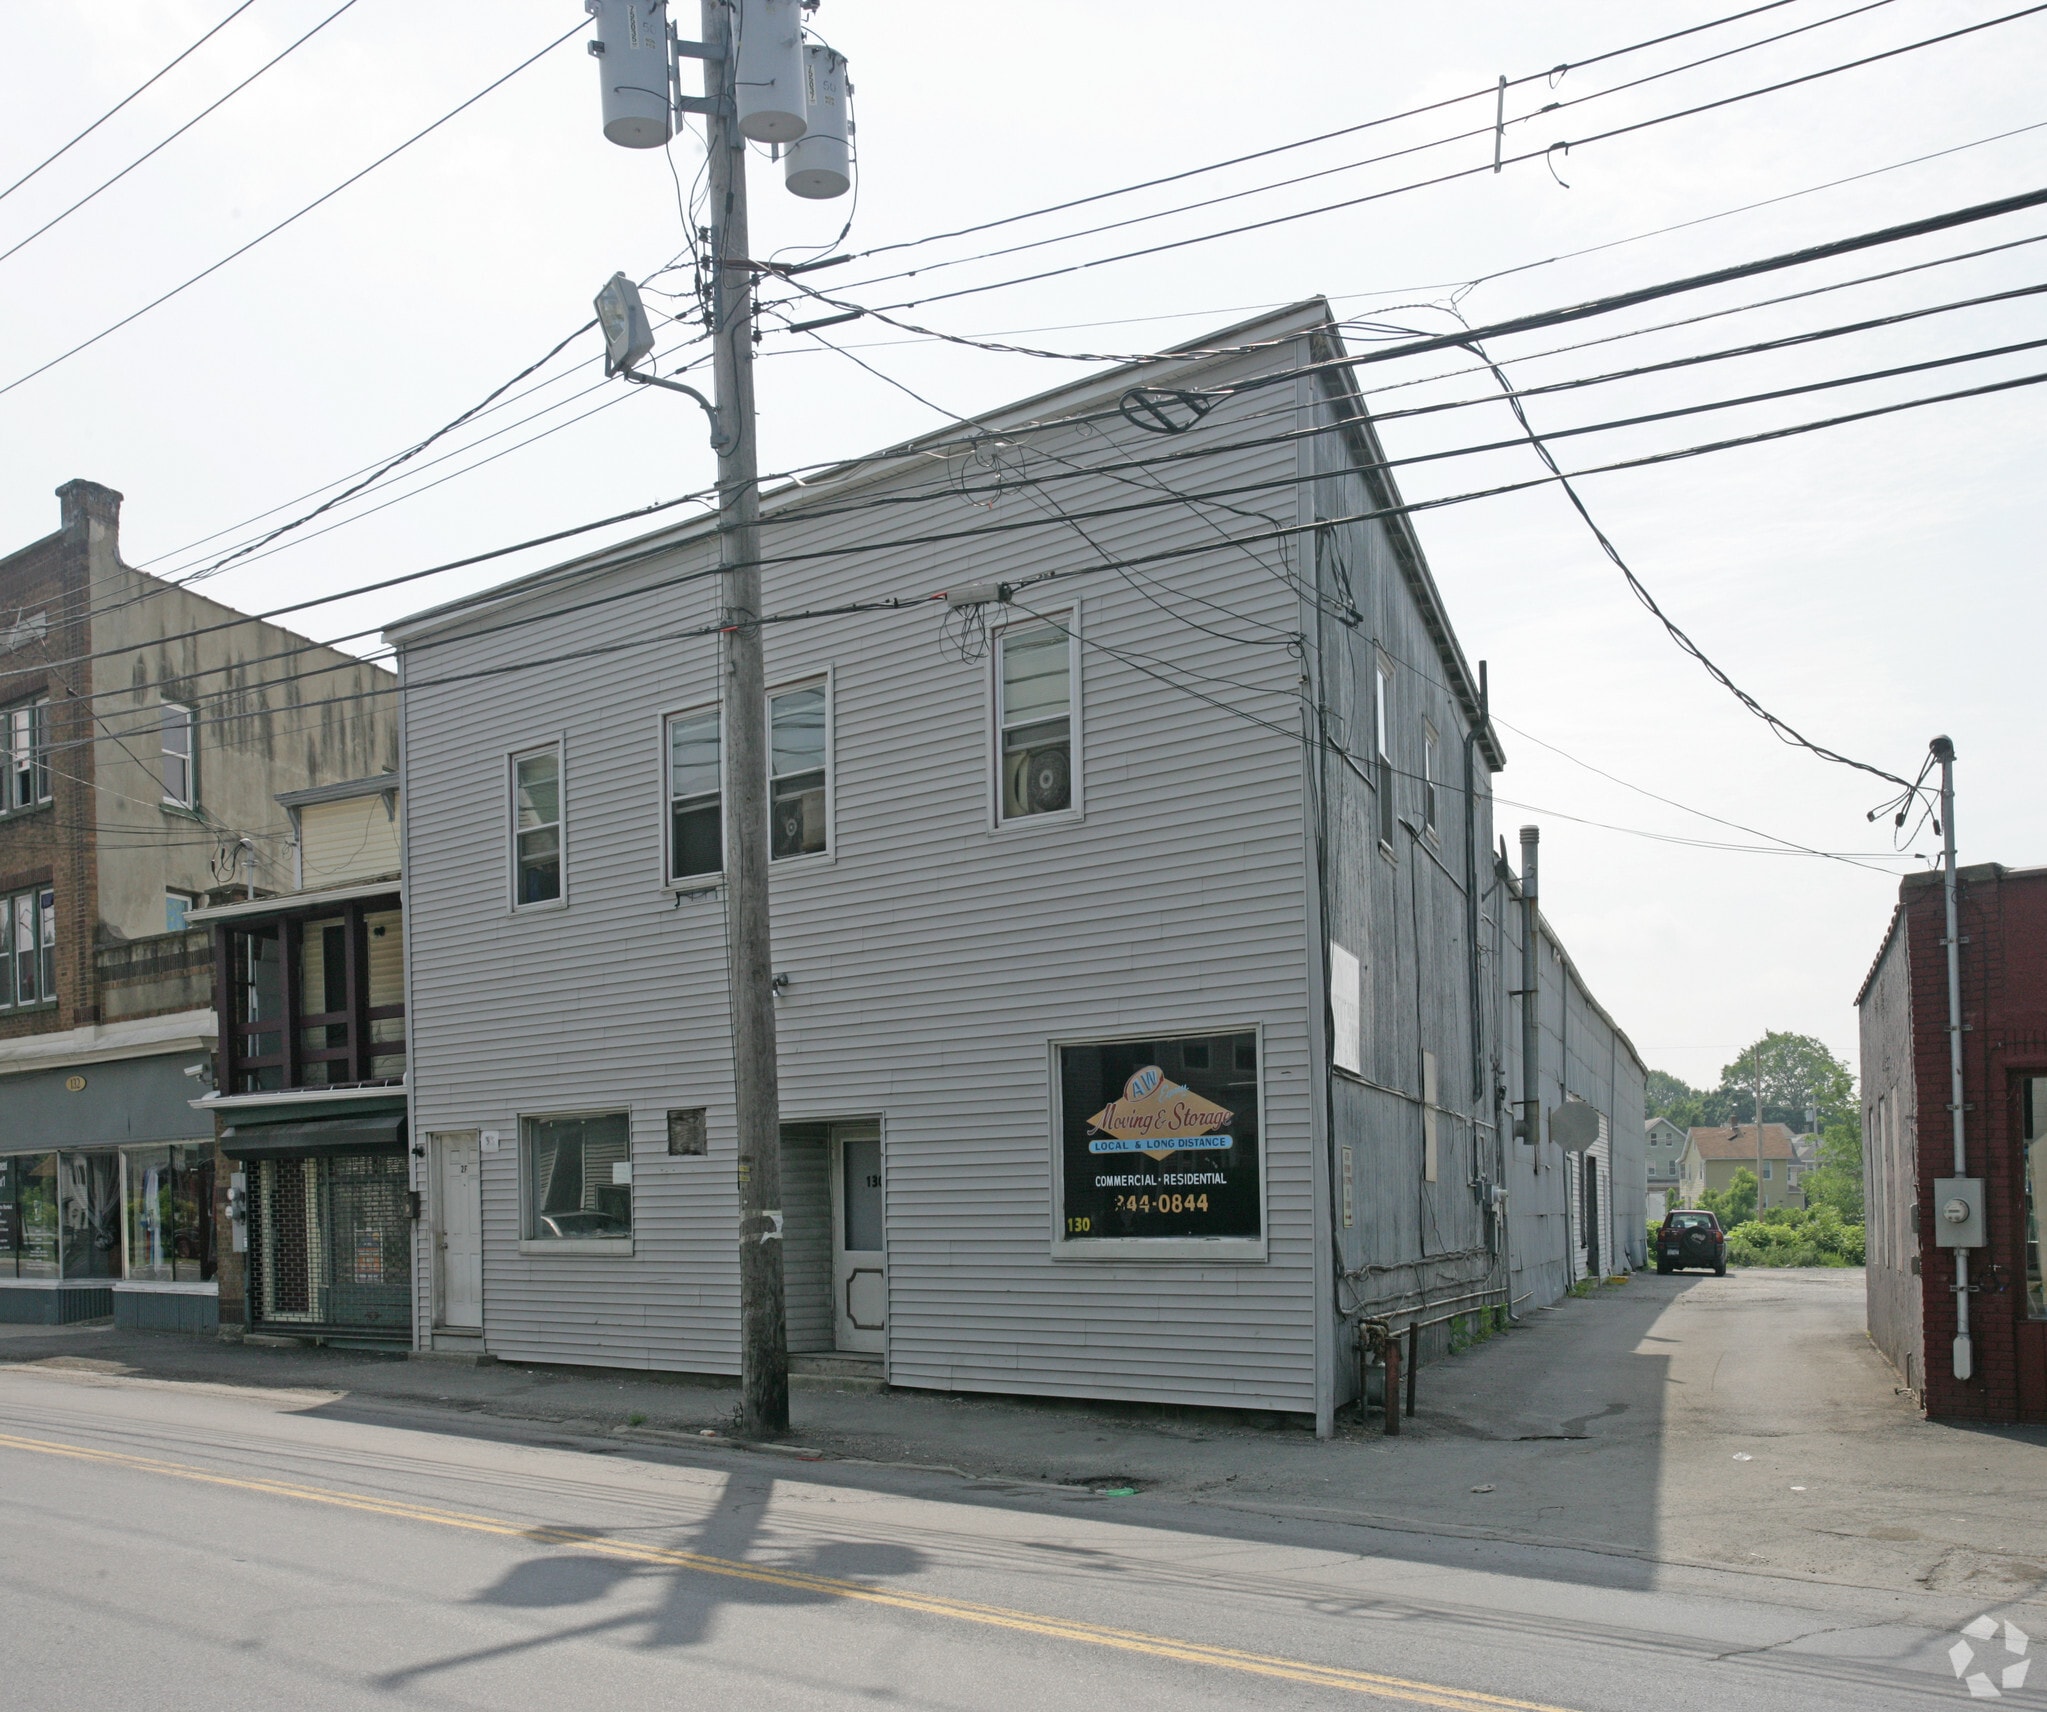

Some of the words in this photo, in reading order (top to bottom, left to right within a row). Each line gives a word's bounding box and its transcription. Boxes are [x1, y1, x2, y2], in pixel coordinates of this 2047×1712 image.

[1087, 1102, 1154, 1136] Moving
[1154, 1109, 1167, 1130] &
[1167, 1101, 1232, 1132] Storage
[1094, 1141, 1129, 1151] LOCAL
[1134, 1140, 1142, 1149] &
[1146, 1139, 1175, 1149] LONG
[1178, 1137, 1226, 1148] DISTANCE
[866, 1175, 882, 1188] 13
[1095, 1174, 1157, 1187] COMMERCIAL
[1163, 1172, 1228, 1185] RESIDENTIAL
[1067, 1217, 1091, 1232] 130
